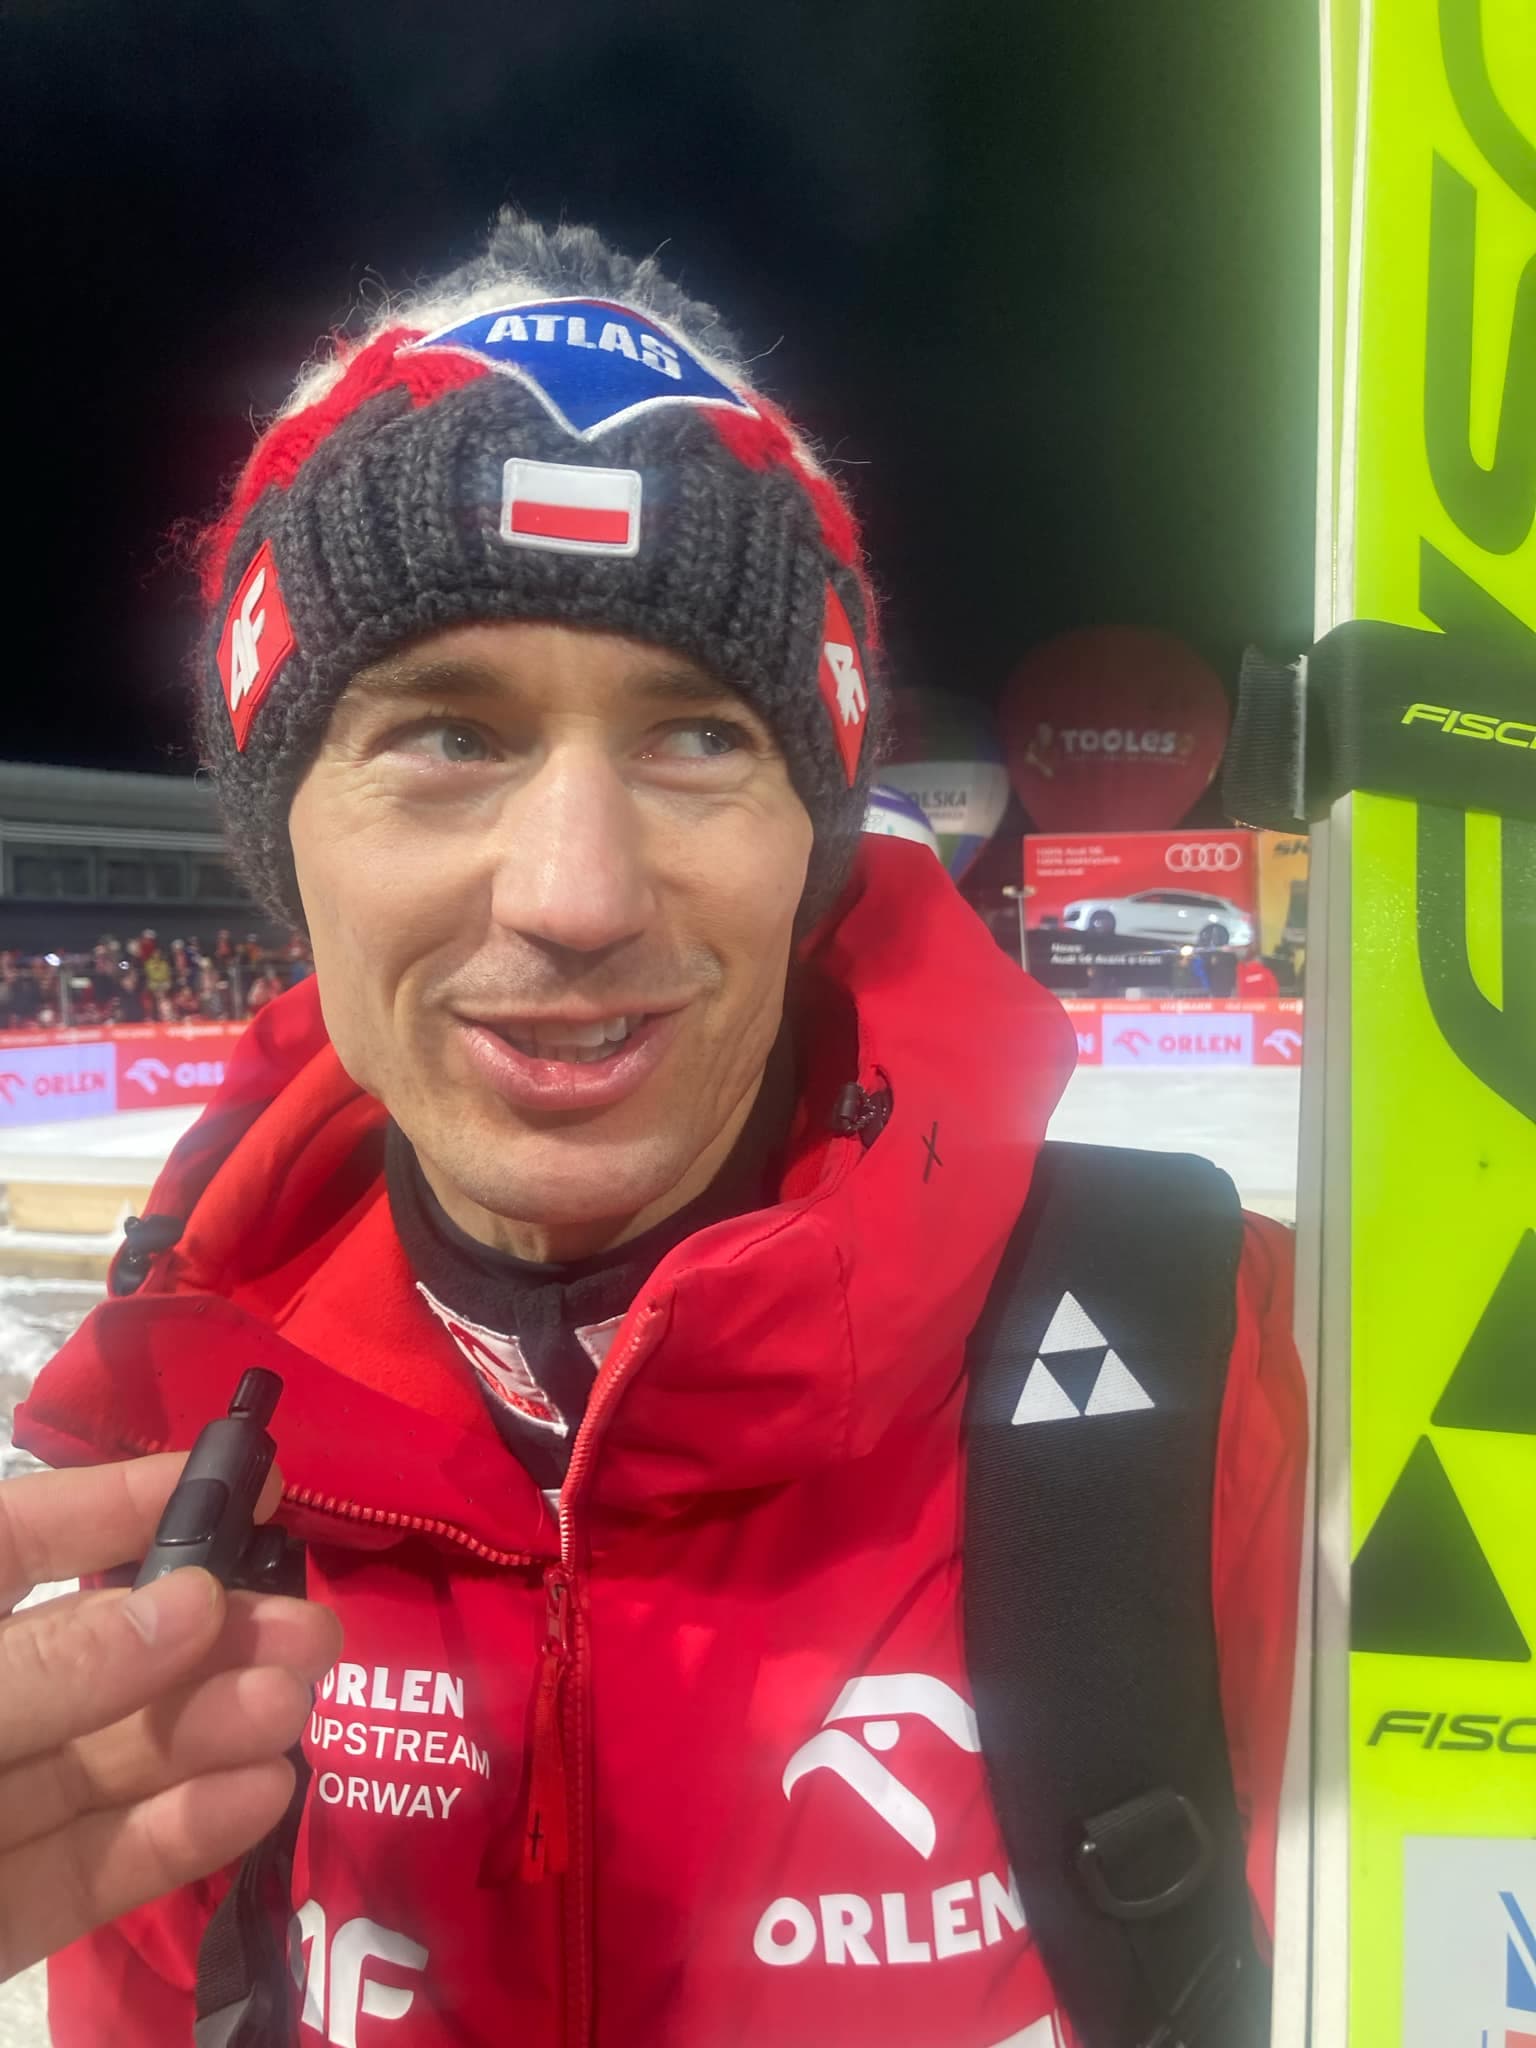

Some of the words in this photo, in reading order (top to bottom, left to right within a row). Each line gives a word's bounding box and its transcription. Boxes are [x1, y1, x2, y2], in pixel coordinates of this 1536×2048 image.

[486, 314, 681, 380] ATLAS
[1401, 703, 1536, 749] FISC
[1157, 1034, 1242, 1055] ORLEN
[32, 1070, 106, 1096] ORLEN
[310, 1711, 490, 1780] UPSTREAM
[315, 1769, 462, 1819] ORWAY
[752, 1865, 1027, 1967] ORLEN
